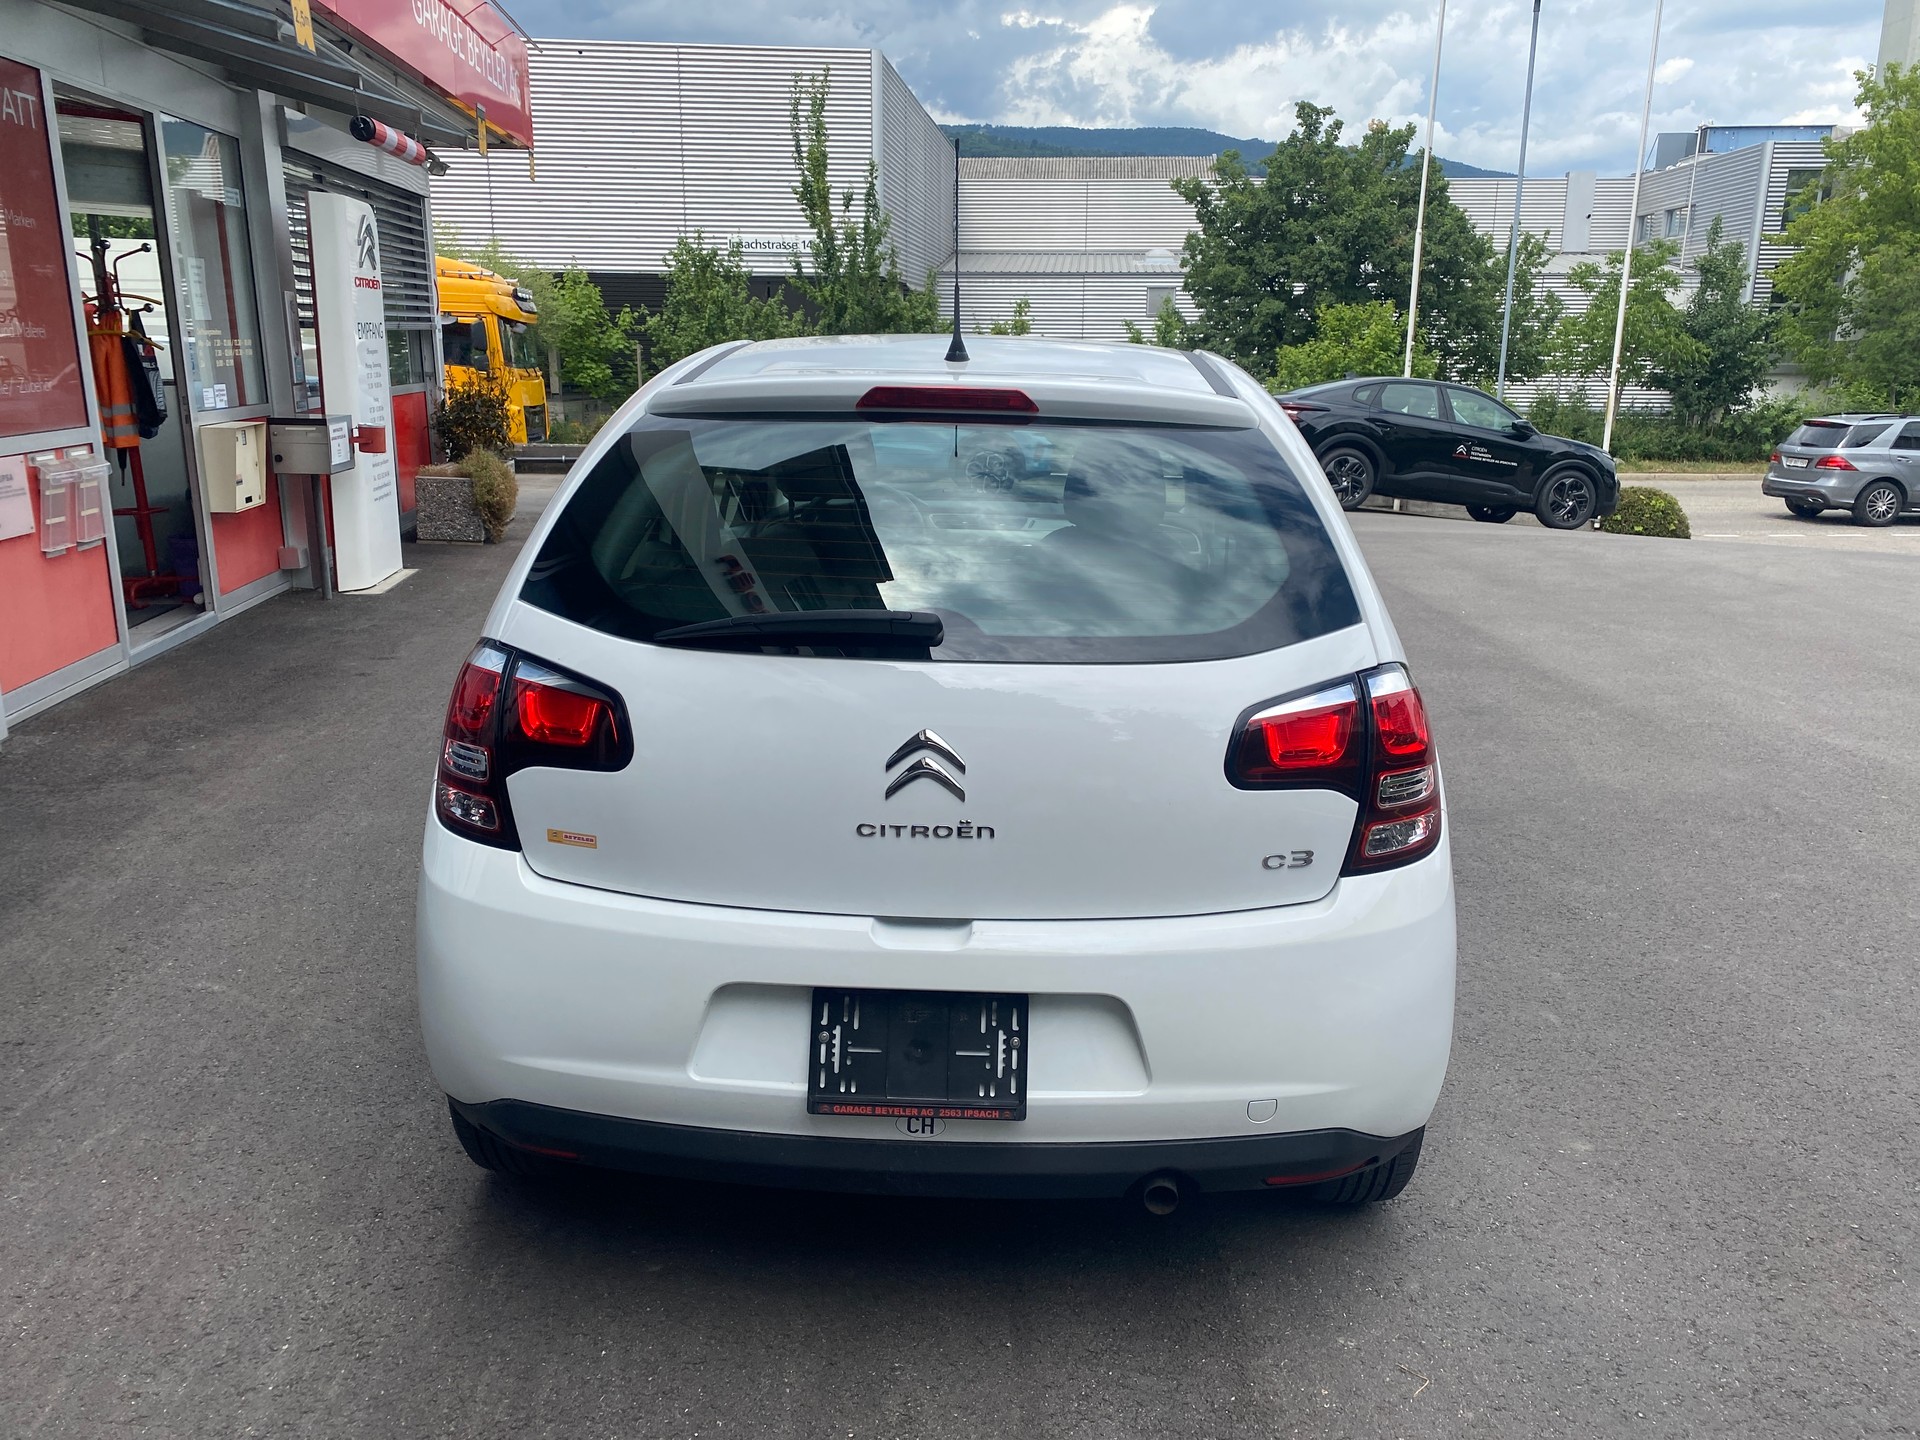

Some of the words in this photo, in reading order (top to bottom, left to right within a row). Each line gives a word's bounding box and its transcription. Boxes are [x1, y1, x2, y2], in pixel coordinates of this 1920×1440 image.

[412, 0, 466, 60] GARAGE
[466, 26, 509, 95] BEYELER
[0, 87, 36, 129] ATT
[357, 322, 384, 340] EMPFANG
[1261, 849, 1315, 870] C3
[833, 1105, 873, 1114] GARAGE
[875, 1106, 918, 1116] BEYELER
[920, 1108, 934, 1116] AG
[939, 1108, 962, 1118] 2563
[964, 1110, 999, 1119] IPSACH
[906, 1116, 936, 1134] CH
